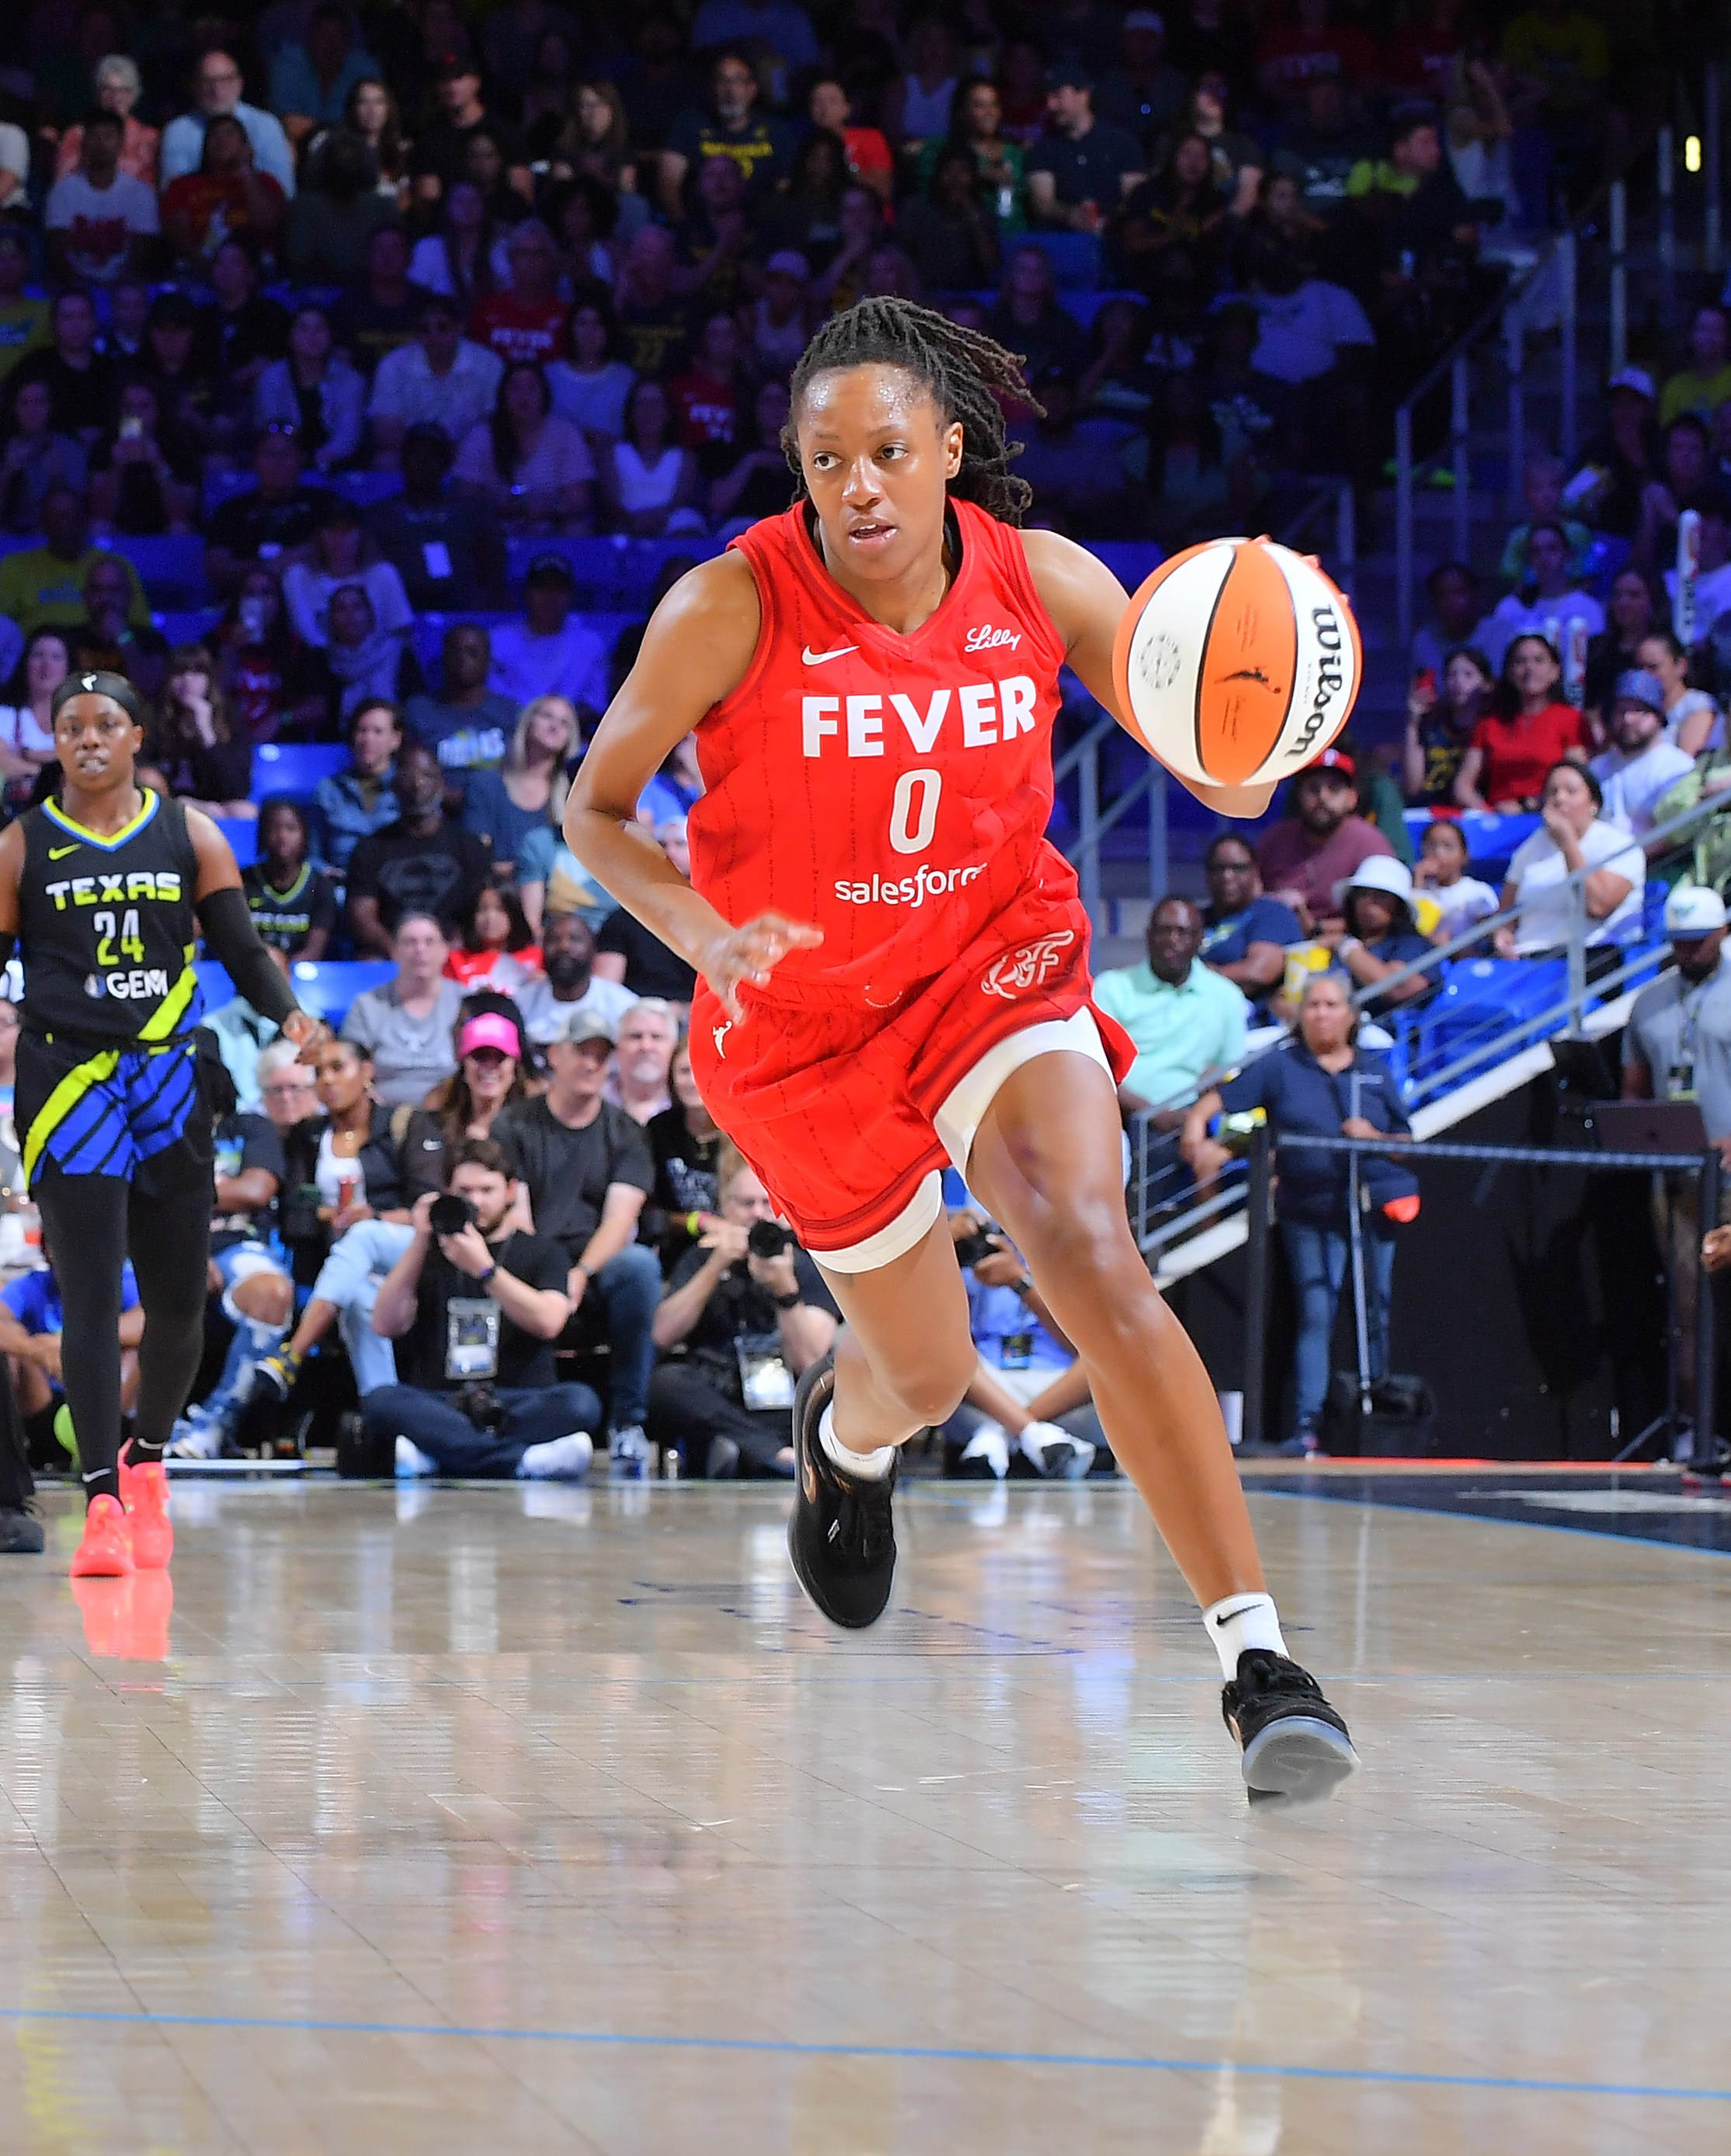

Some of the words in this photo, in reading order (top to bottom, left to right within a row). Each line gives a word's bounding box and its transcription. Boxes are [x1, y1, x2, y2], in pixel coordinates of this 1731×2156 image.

[964, 624, 1021, 652] Lilly
[1284, 603, 1342, 757] Wilson
[801, 675, 1037, 758] FEVER
[889, 768, 942, 854] 0
[45, 871, 181, 910] TEXAS
[834, 862, 988, 908] salesfor
[93, 909, 145, 965] 24
[106, 969, 169, 1000] GEM
